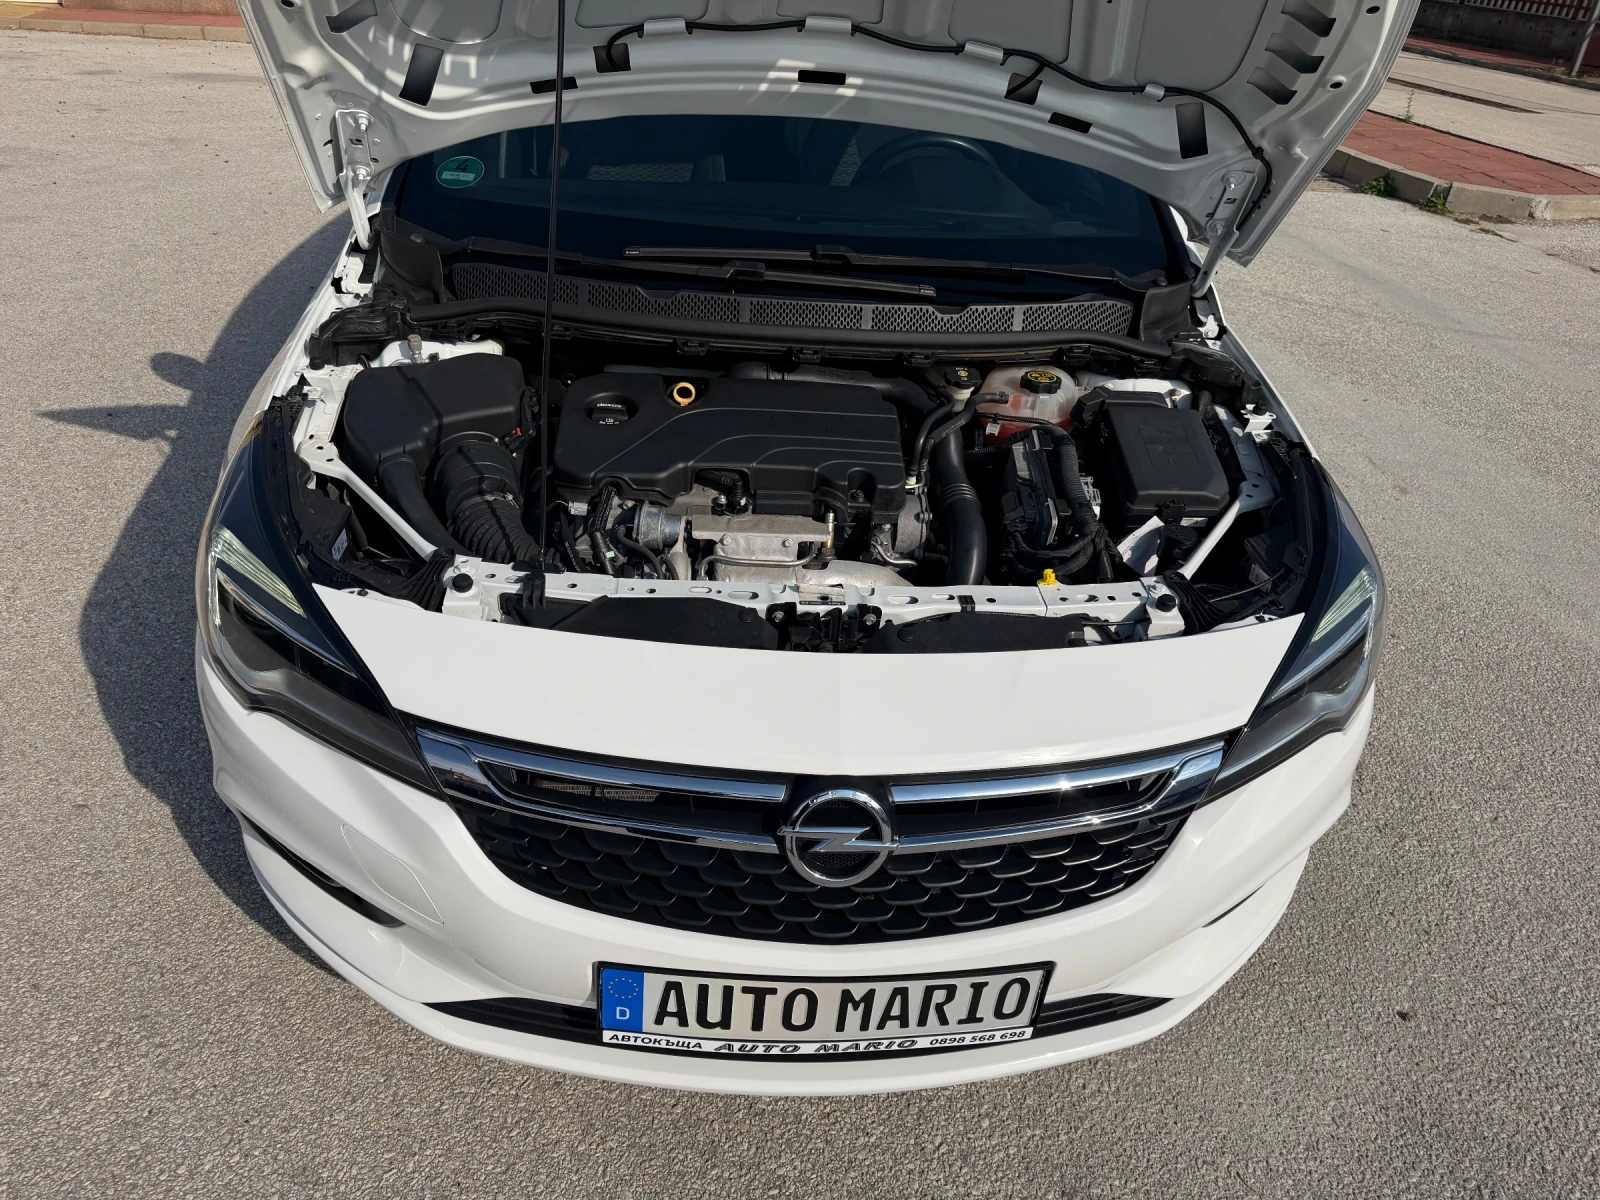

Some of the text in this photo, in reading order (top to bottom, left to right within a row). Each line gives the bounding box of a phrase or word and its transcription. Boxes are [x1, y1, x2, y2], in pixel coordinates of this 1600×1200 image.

[455, 158, 471, 173] 4
[615, 1006, 630, 1020] D
[653, 977, 1031, 1033] AUTO MARIO
[608, 1030, 1026, 1054] АВТОКЪЩА AUTO MARIO 0898 568 698
